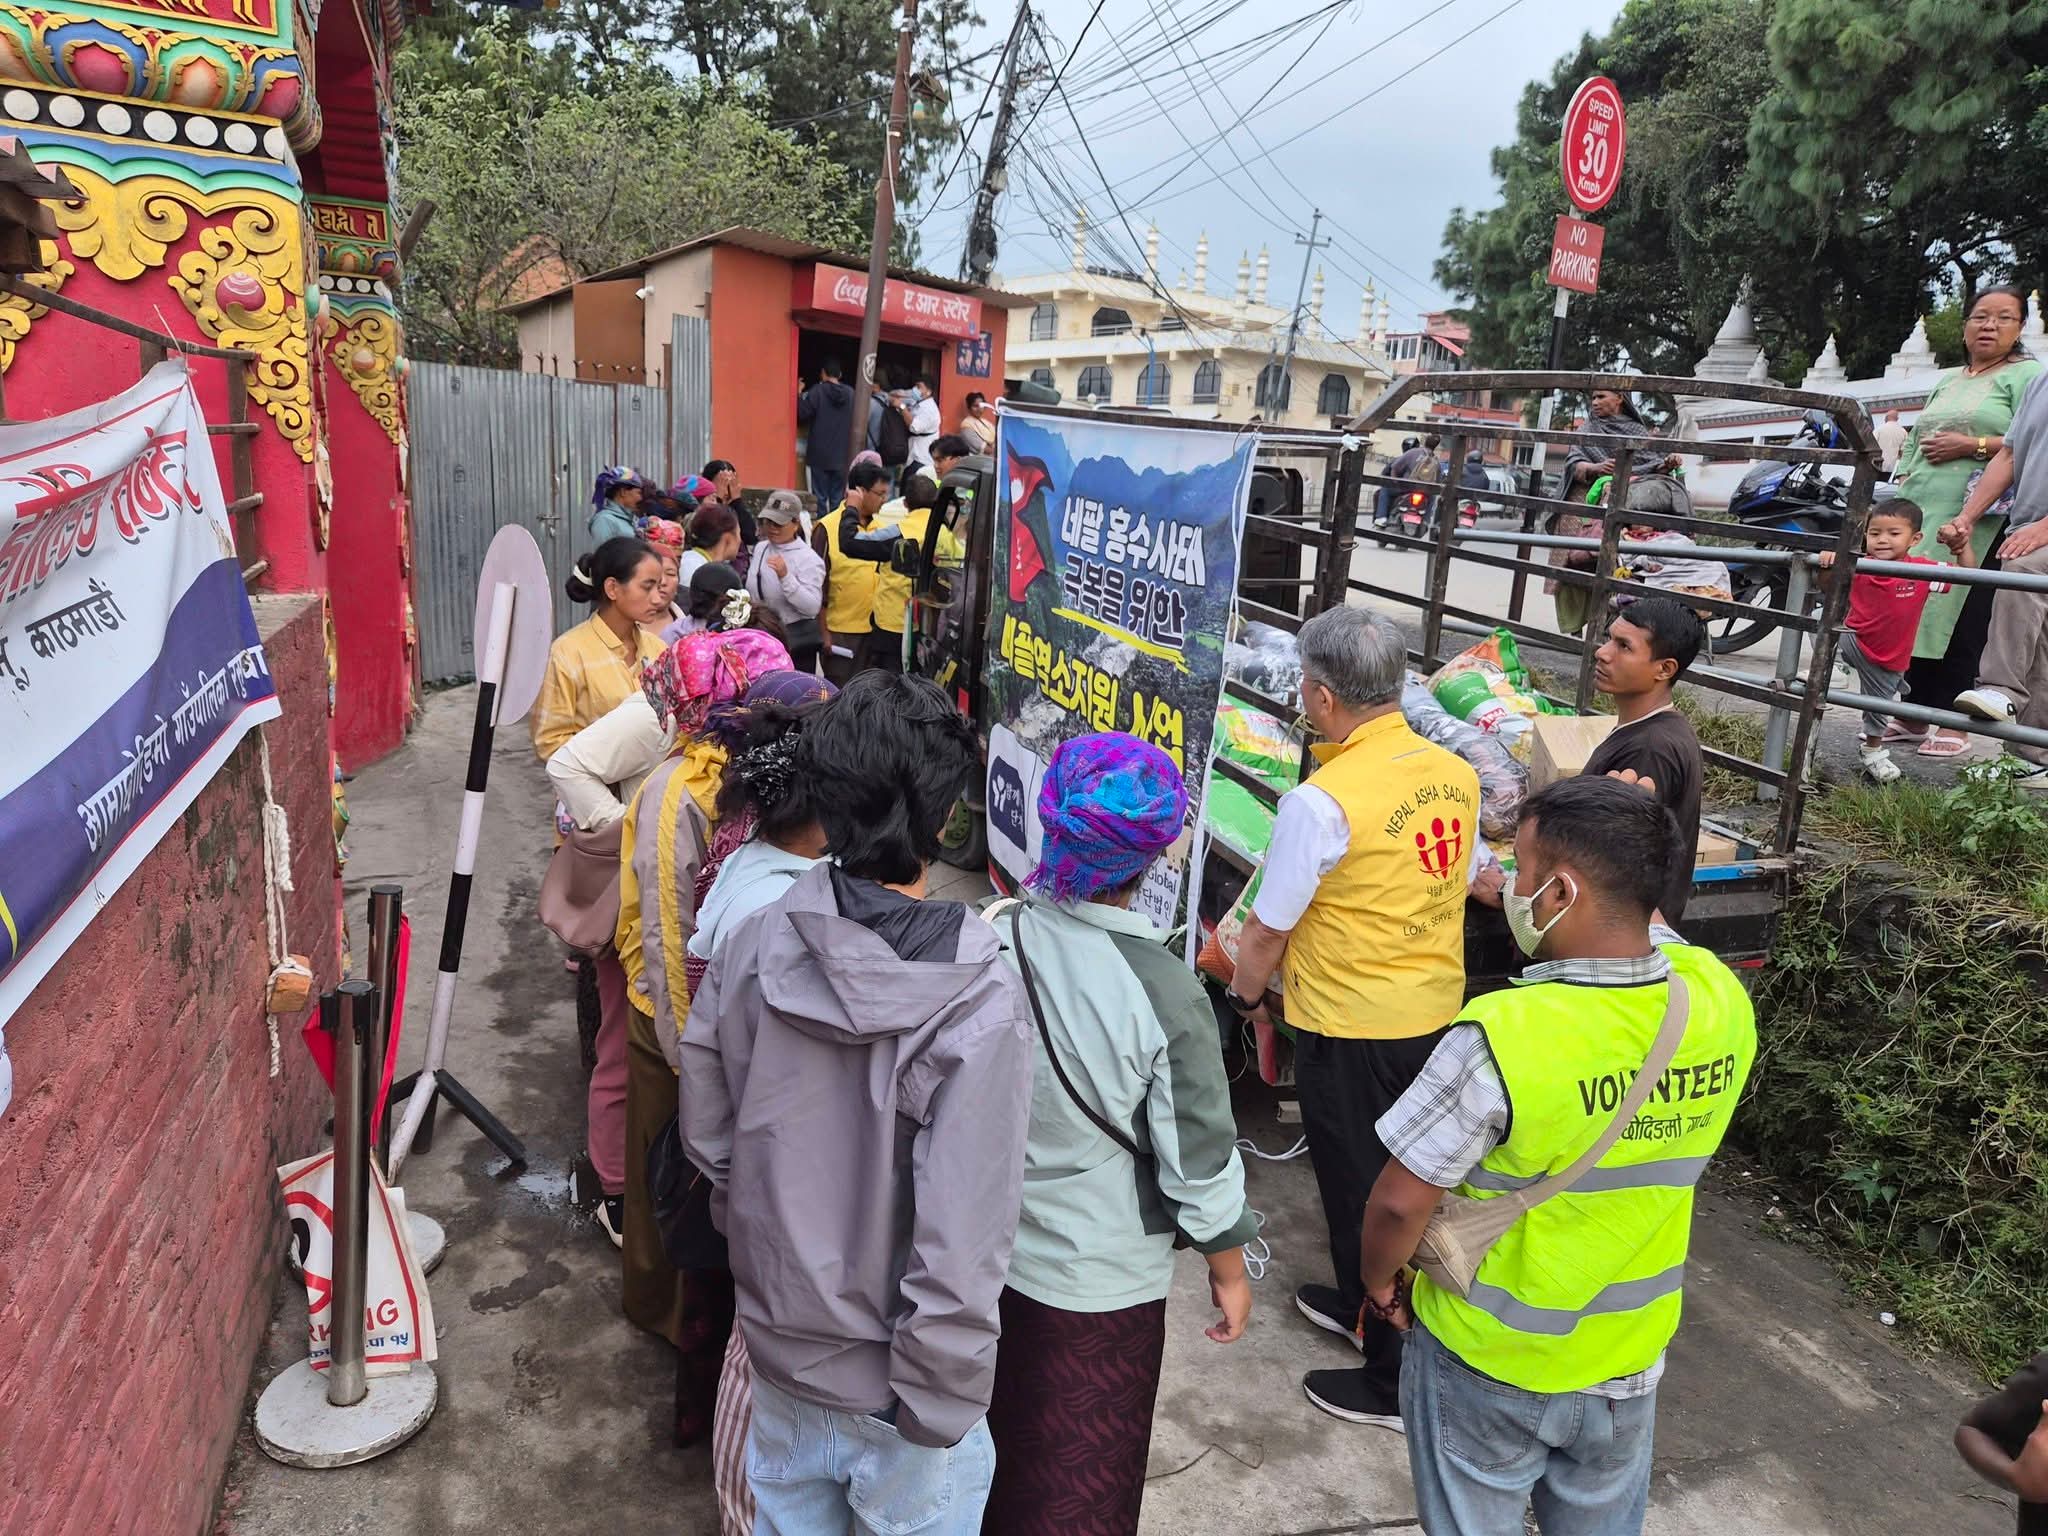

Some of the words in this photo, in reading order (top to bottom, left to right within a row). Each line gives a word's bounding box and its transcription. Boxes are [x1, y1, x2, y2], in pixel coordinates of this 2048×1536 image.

[1588, 97, 1614, 121] SPEED
[1588, 118, 1609, 138] LIMIT
[1578, 132, 1609, 180] 30
[1577, 175, 1601, 196] Kmph
[1570, 225, 1587, 247] NO
[1550, 248, 1597, 284] PARKING
[1060, 495, 1104, 555] 네팔
[1105, 506, 1206, 586] 홍수사태
[1063, 553, 1126, 627] 극복을
[1127, 577, 1186, 649] 위한
[1384, 801, 1415, 838] NEPAL
[1414, 785, 1440, 808] ASHA
[1443, 783, 1471, 811] SADAN
[1136, 887, 1172, 922] 단법인
[1403, 922, 1427, 937] LOVE
[1431, 910, 1453, 928] SERVE
[1577, 1053, 1735, 1116] VOLNTEER
